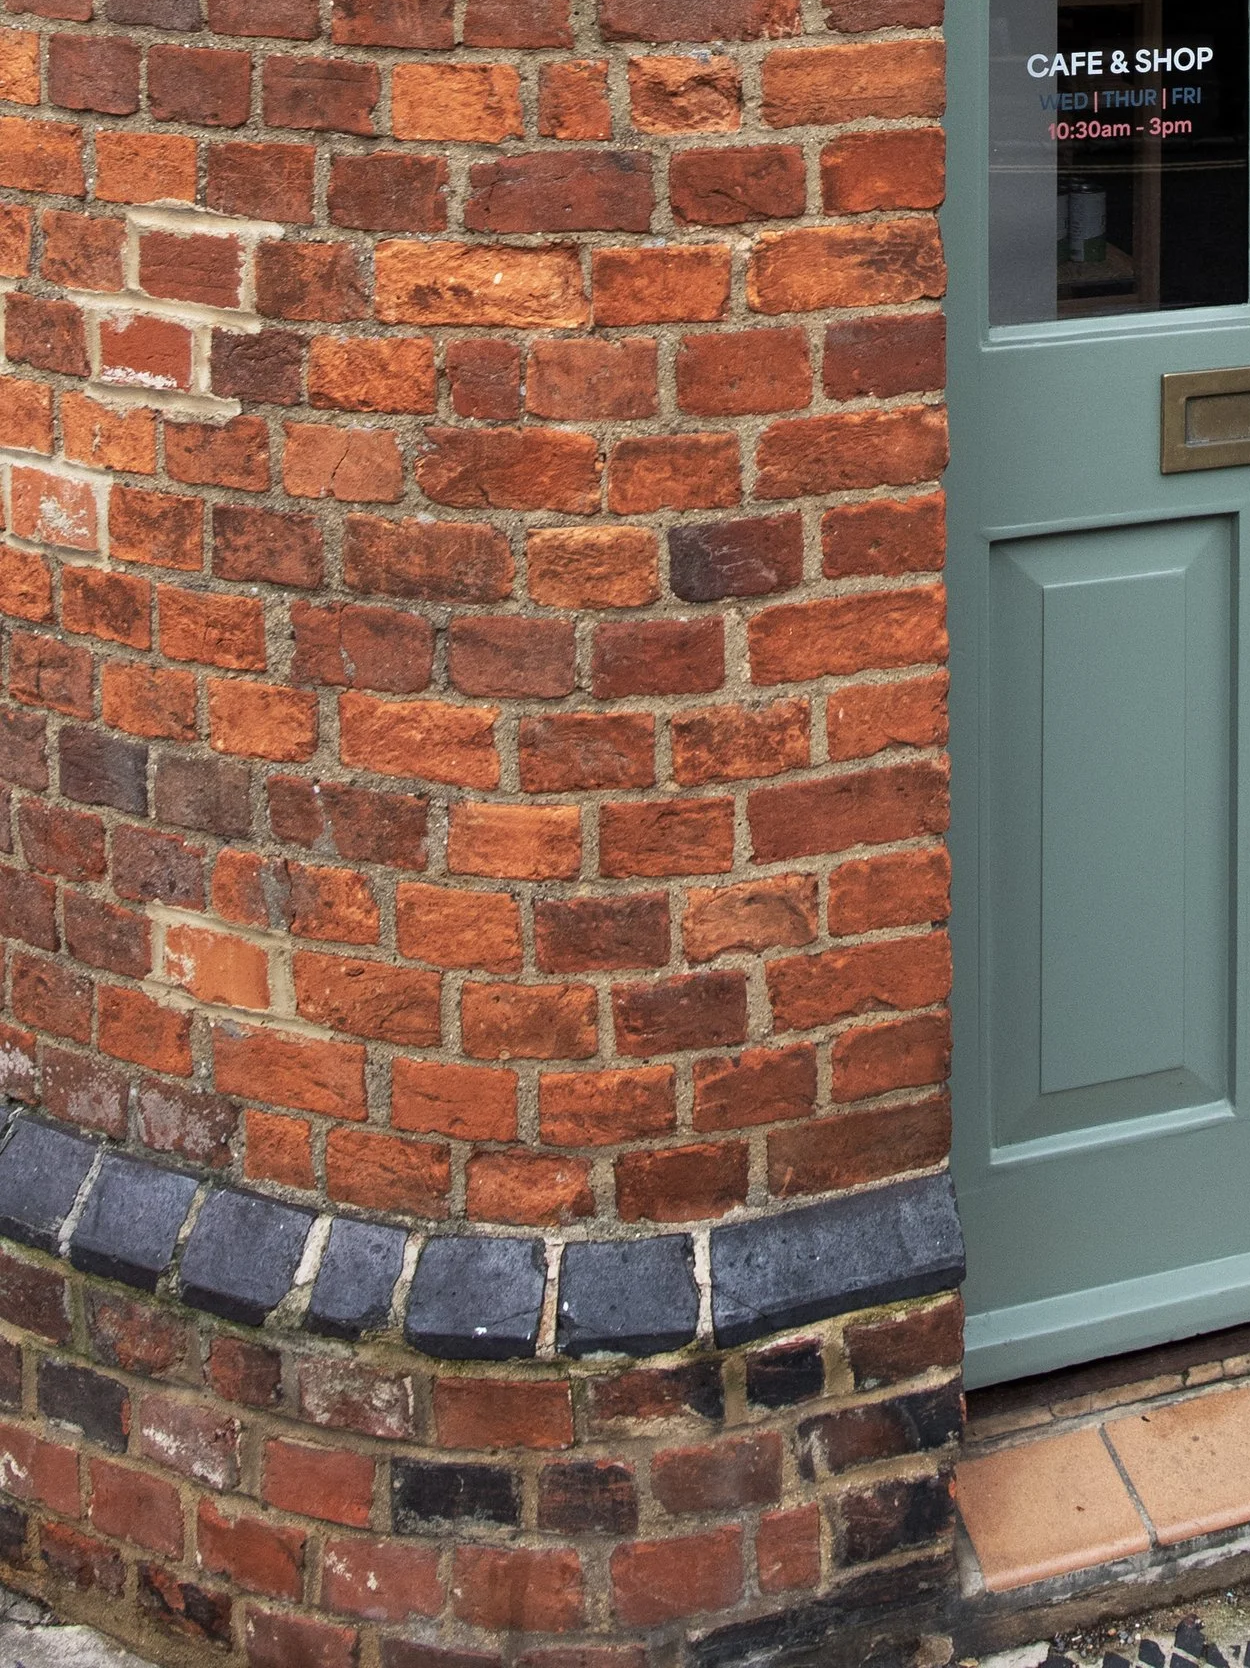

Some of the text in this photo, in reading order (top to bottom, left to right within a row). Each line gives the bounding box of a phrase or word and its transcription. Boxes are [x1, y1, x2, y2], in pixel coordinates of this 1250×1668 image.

[1027, 47, 1214, 78] CAFE & SHOP
[1039, 91, 1089, 111] WED
[1102, 88, 1157, 109] THUR
[1171, 87, 1201, 105] FRI
[1048, 120, 1131, 141] 10:30am
[1149, 117, 1193, 139] 3pm
